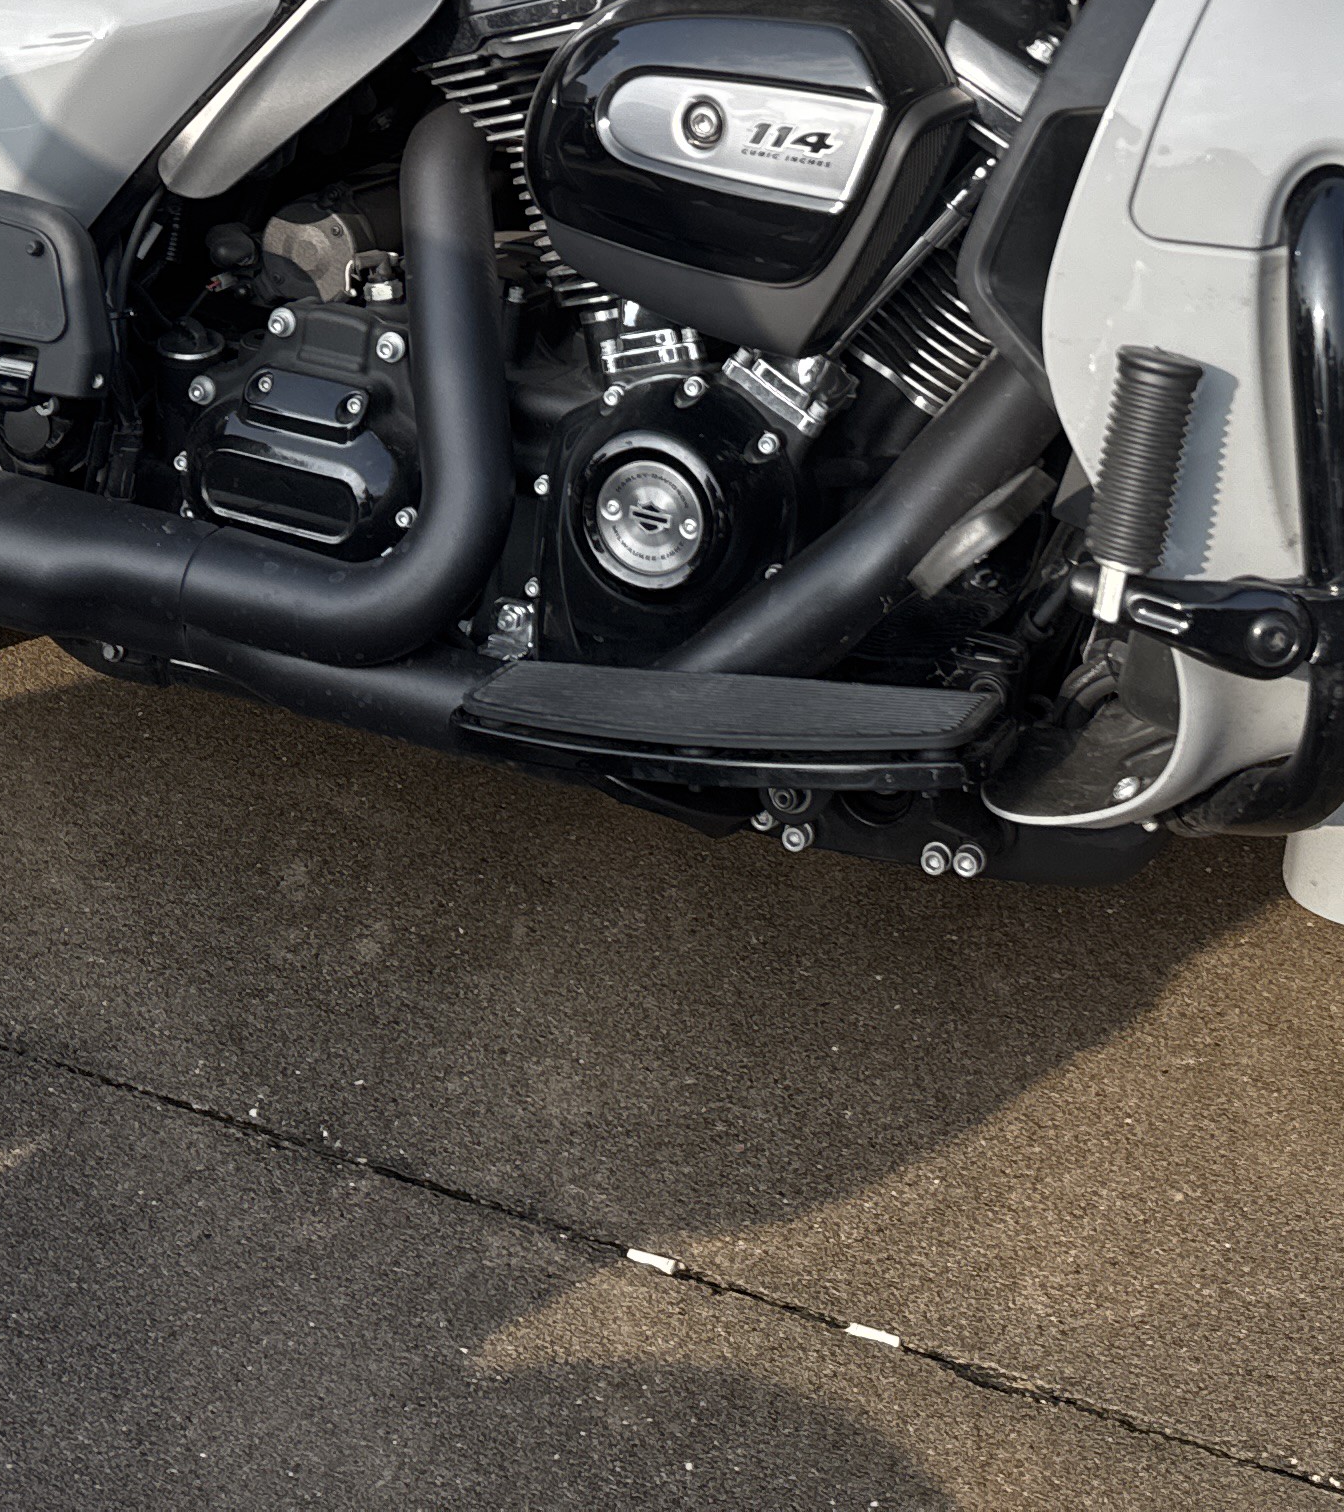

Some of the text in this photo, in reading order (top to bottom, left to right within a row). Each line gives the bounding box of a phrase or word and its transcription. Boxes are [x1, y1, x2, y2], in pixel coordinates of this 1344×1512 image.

[748, 122, 834, 154] 114
[741, 148, 831, 168] CUBIC INCHES
